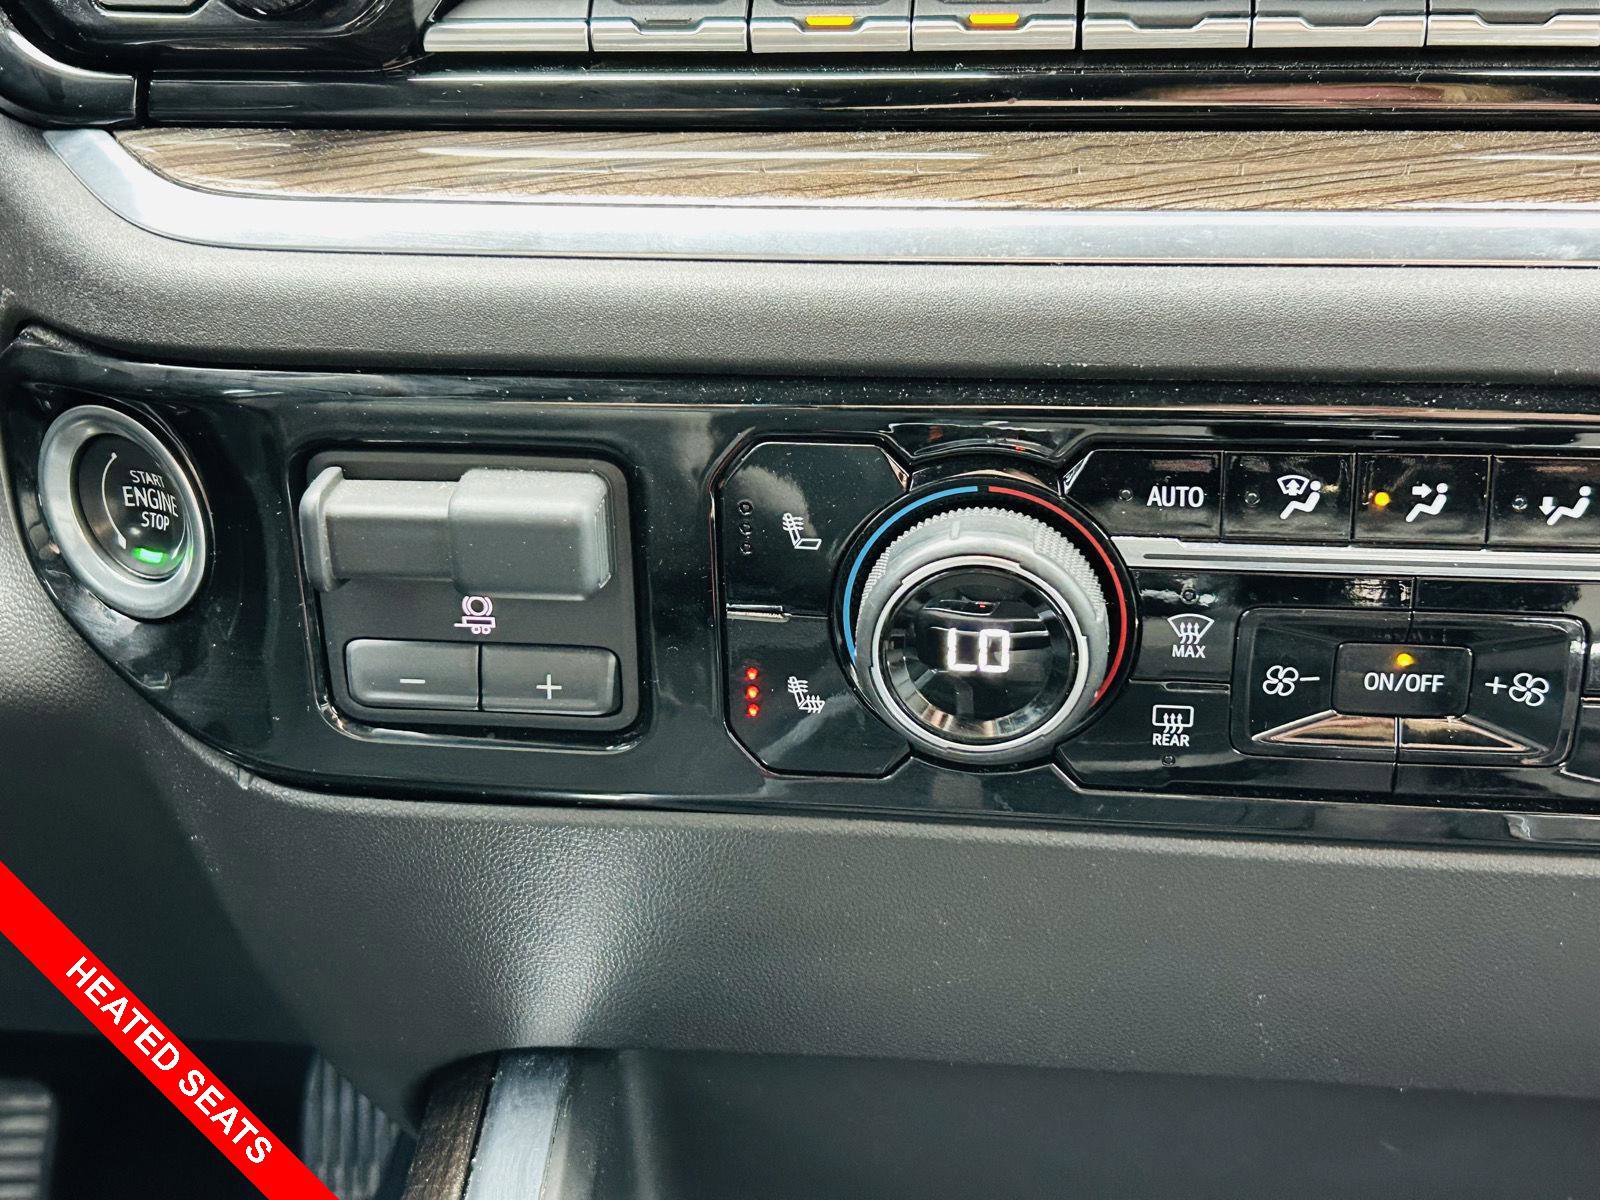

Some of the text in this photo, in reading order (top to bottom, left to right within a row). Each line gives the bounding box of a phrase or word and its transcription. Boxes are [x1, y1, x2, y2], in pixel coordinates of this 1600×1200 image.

[129, 469, 165, 488] START
[122, 485, 179, 518] ENGINE
[1147, 485, 1205, 509] AUTO
[140, 510, 170, 531] STOP
[1171, 643, 1206, 659] MAX
[1363, 671, 1445, 693] ON/OFF
[1152, 731, 1190, 747] REAR
